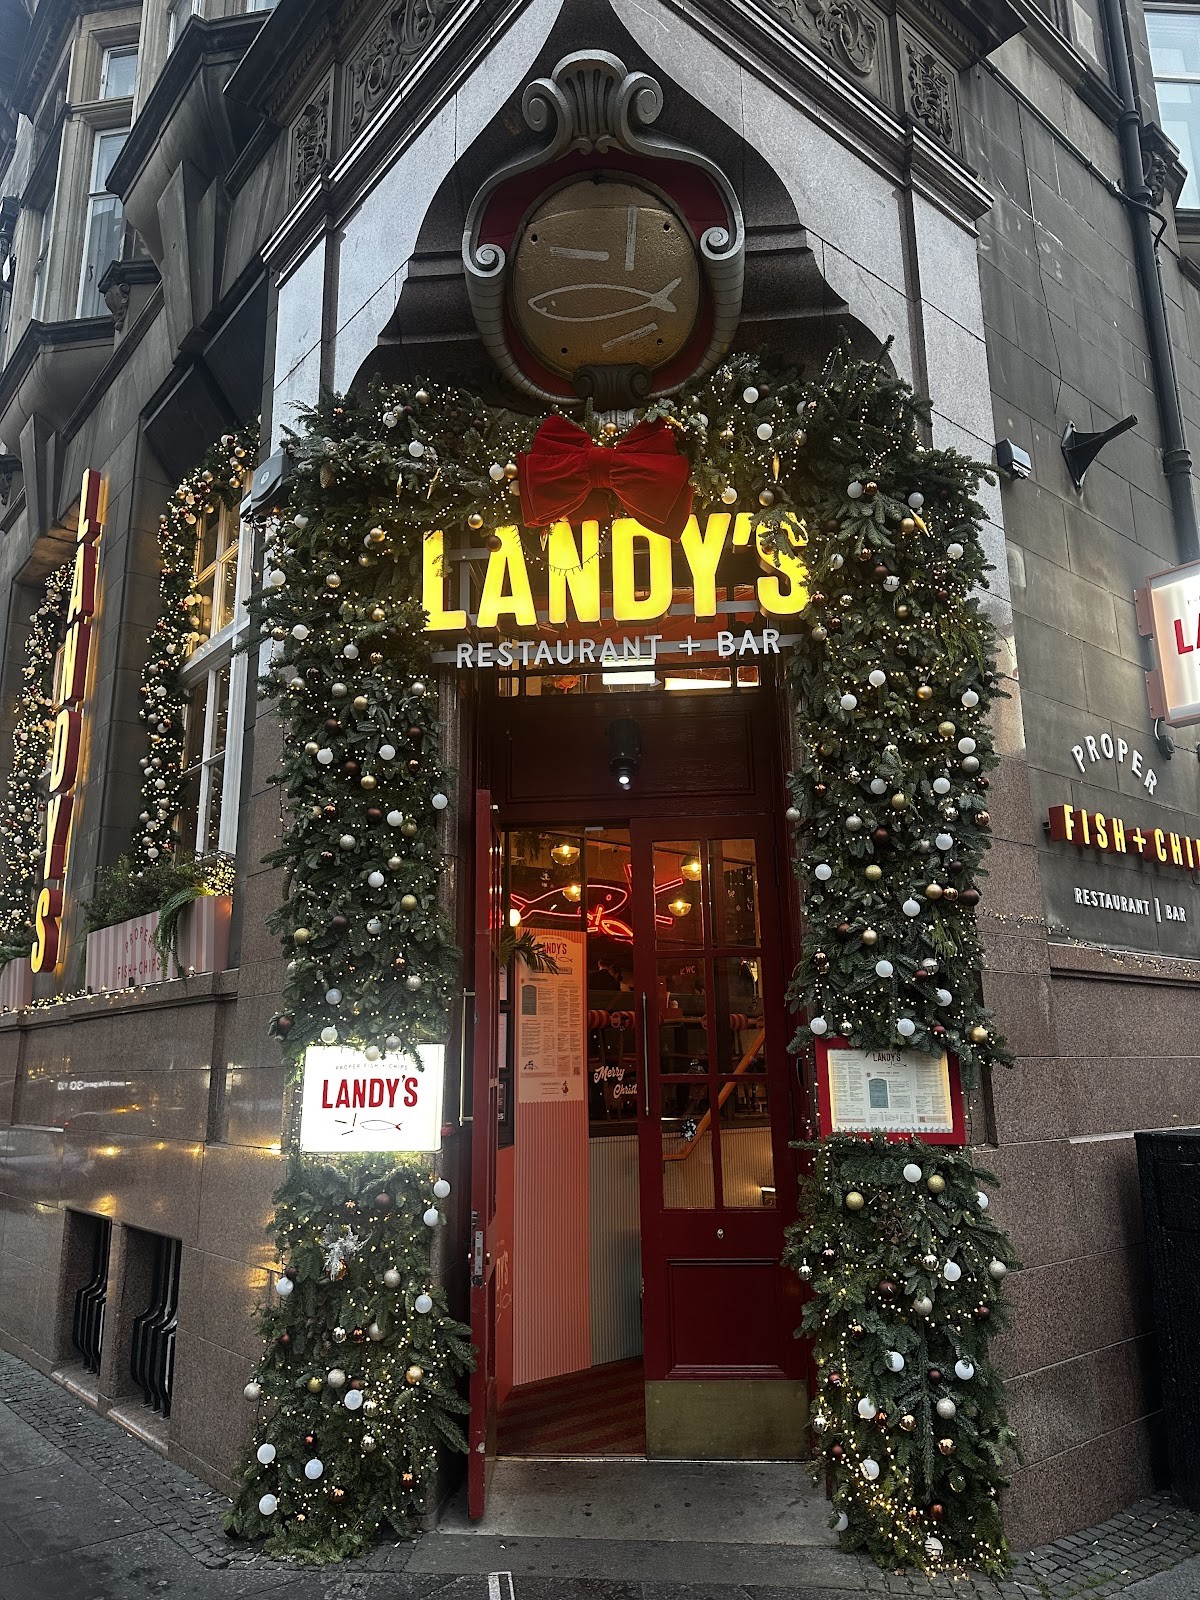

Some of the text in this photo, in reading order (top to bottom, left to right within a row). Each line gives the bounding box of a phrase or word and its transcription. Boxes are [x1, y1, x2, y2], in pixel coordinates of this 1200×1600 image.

[422, 511, 810, 632] LANDY'S
[456, 634, 662, 669] RESTAURANT
[717, 629, 781, 657] BAR
[1071, 732, 1159, 796] PROPER
[1073, 887, 1150, 916] RESTAURANT
[1164, 904, 1187, 923] BAR
[593, 1065, 626, 1084] Merry
[872, 1051, 901, 1062] LANDY'S
[321, 1074, 419, 1109] LANDY'S
